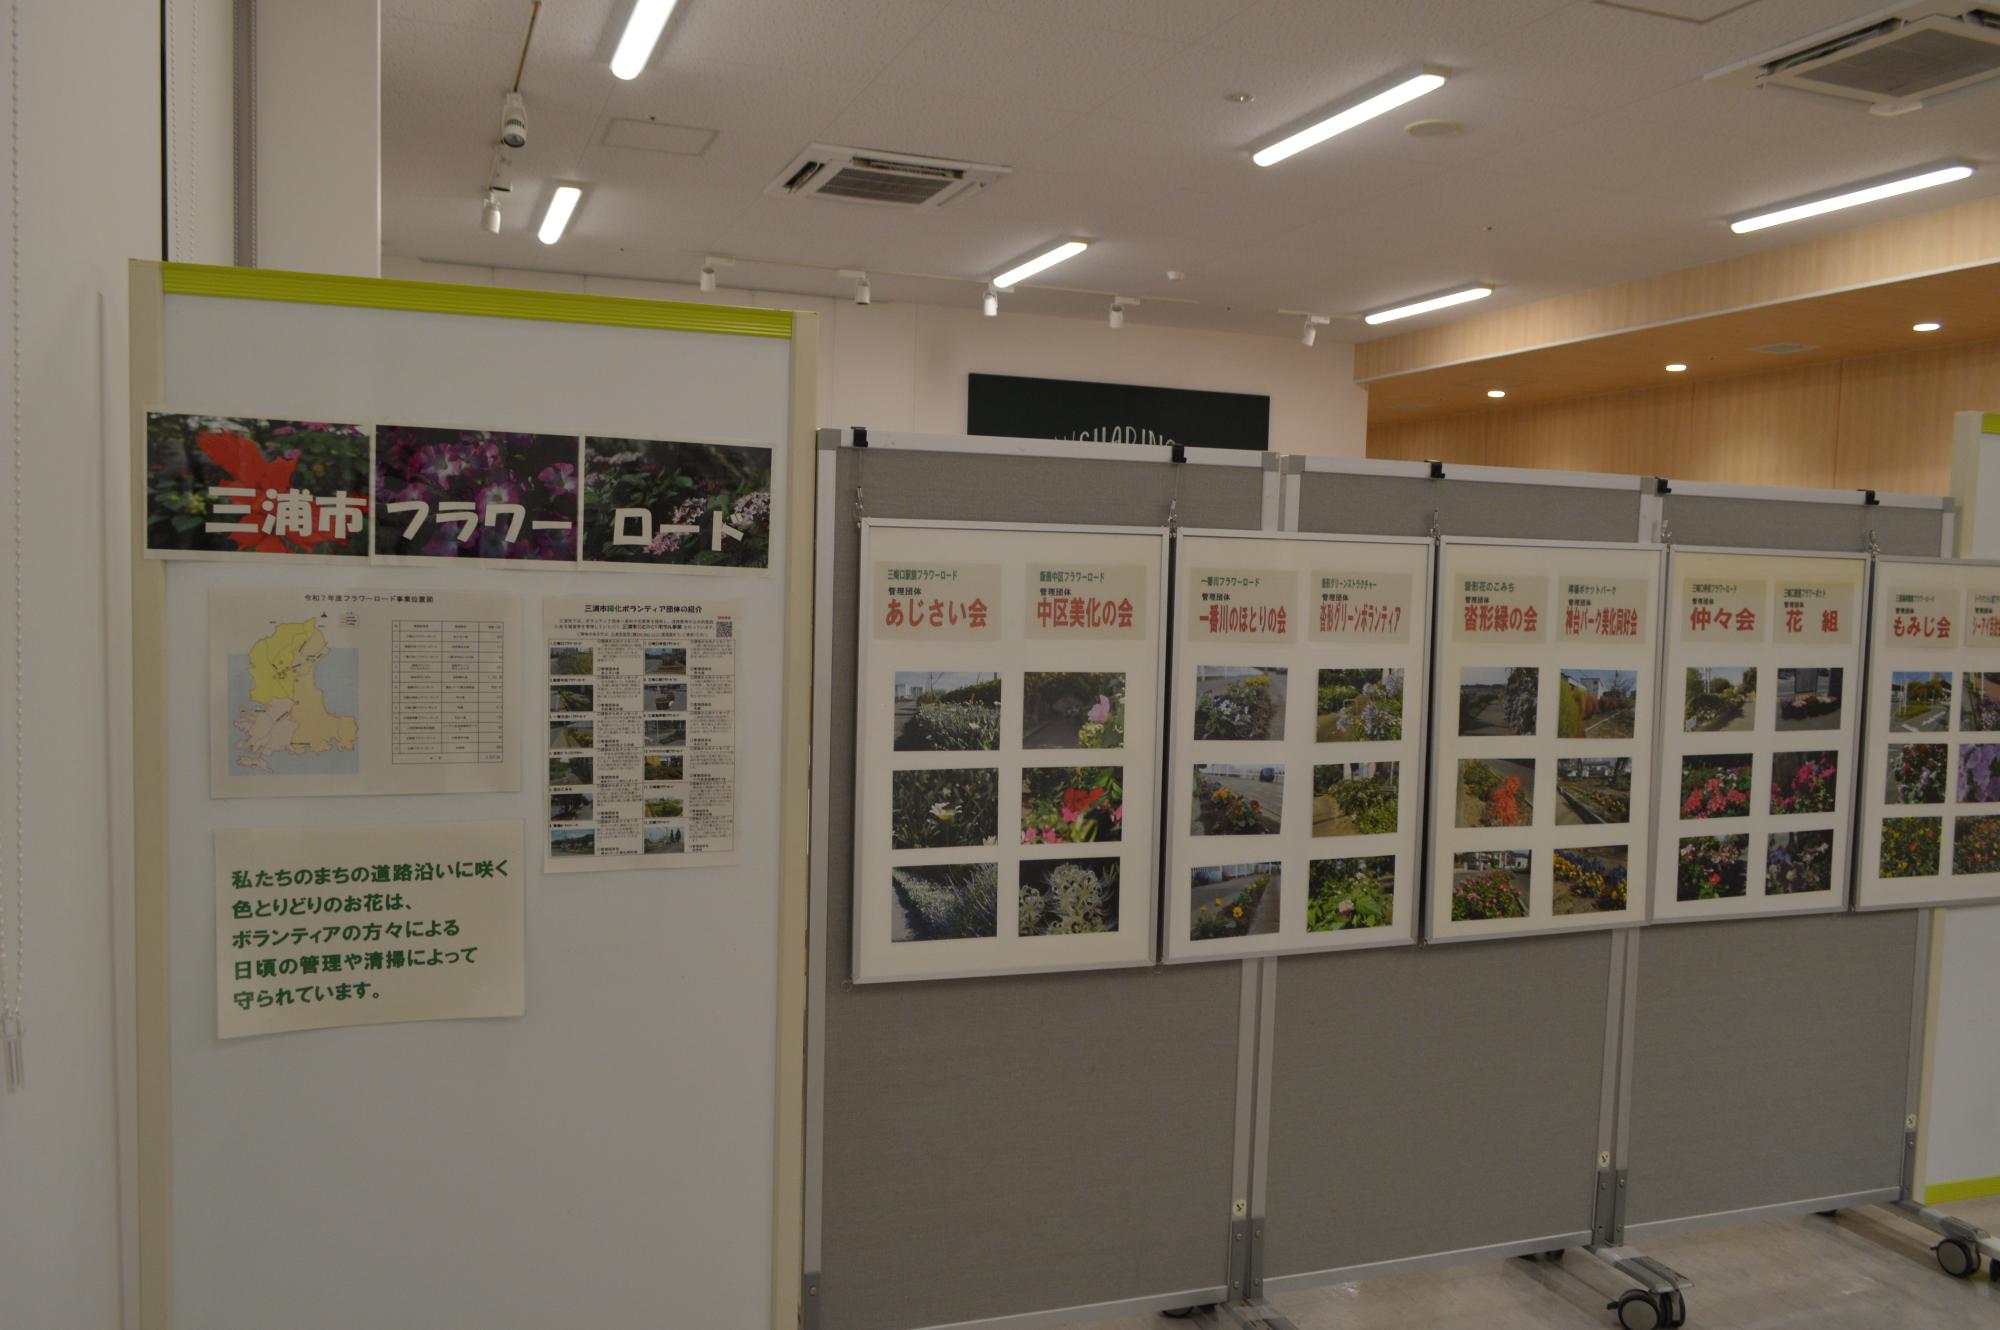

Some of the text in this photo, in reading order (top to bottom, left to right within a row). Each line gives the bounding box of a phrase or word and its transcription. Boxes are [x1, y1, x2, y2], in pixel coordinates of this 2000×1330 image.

[205, 486, 746, 552] 三浦市 フラワー ロード
[888, 587, 922, 596] 管理団体
[1039, 588, 1072, 597] 管理団体
[886, 598, 988, 629] あじさい会
[1037, 598, 1133, 629] 中区美化の会
[1199, 604, 1287, 634] 一番川のほとりの会
[1464, 605, 1537, 632] 沓形緑の会
[1691, 607, 1755, 632] 仲々会
[1894, 616, 1951, 638] もみじ会
[231, 859, 509, 889] 私たちのまちの道路沿いに咲く
[231, 892, 412, 919] 色とりどりのお花は、
[231, 918, 460, 950] ボランティアの方々による
[234, 946, 478, 980] 日頃の管理や清掃によって
[232, 981, 380, 1011] 守られています。
